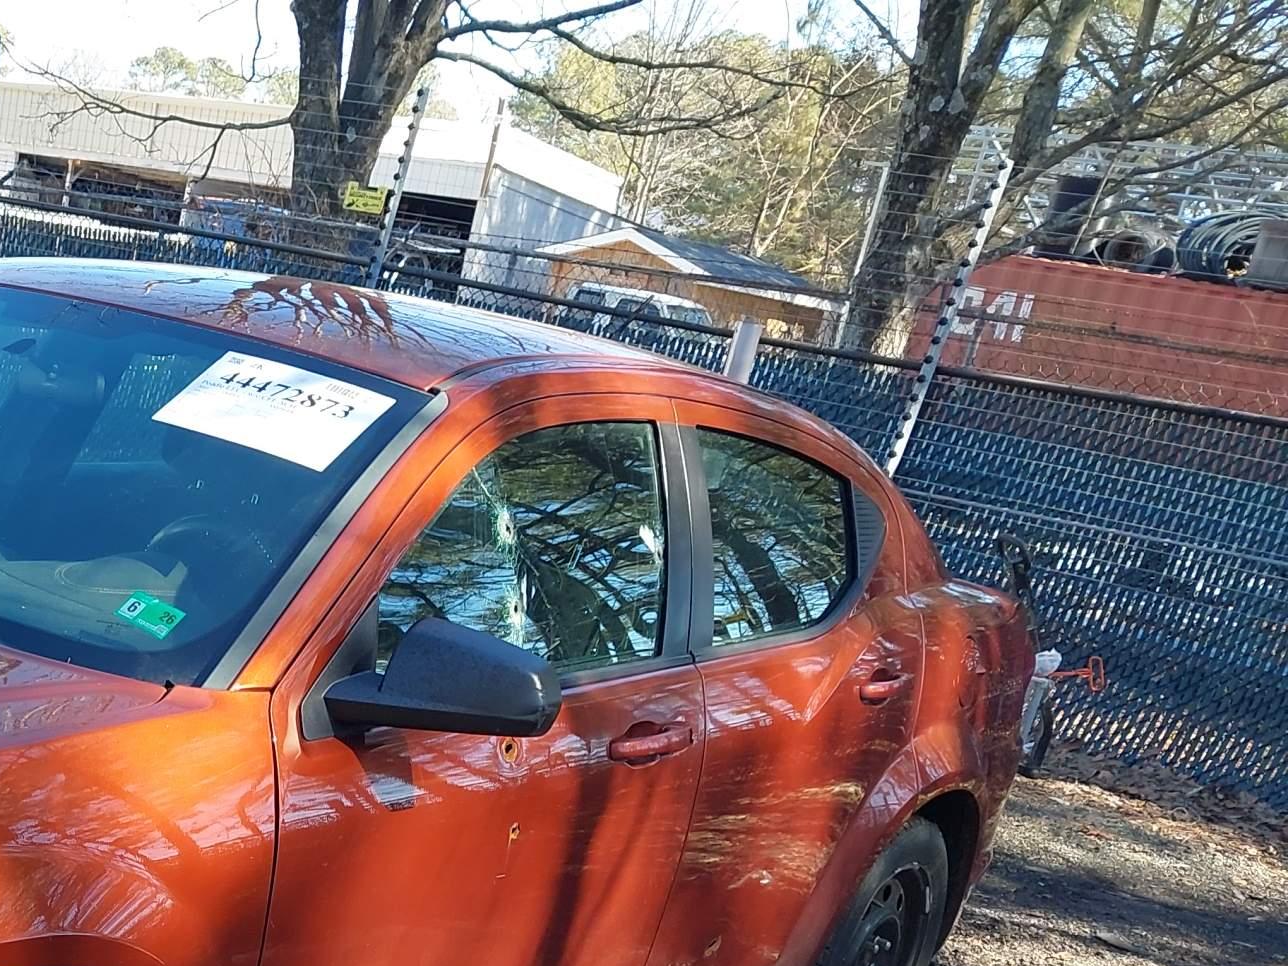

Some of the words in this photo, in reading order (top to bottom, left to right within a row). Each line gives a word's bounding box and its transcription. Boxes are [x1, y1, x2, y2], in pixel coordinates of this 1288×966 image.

[219, 371, 356, 420] 44472873
[127, 601, 142, 613] 6
[159, 611, 177, 625] 26
